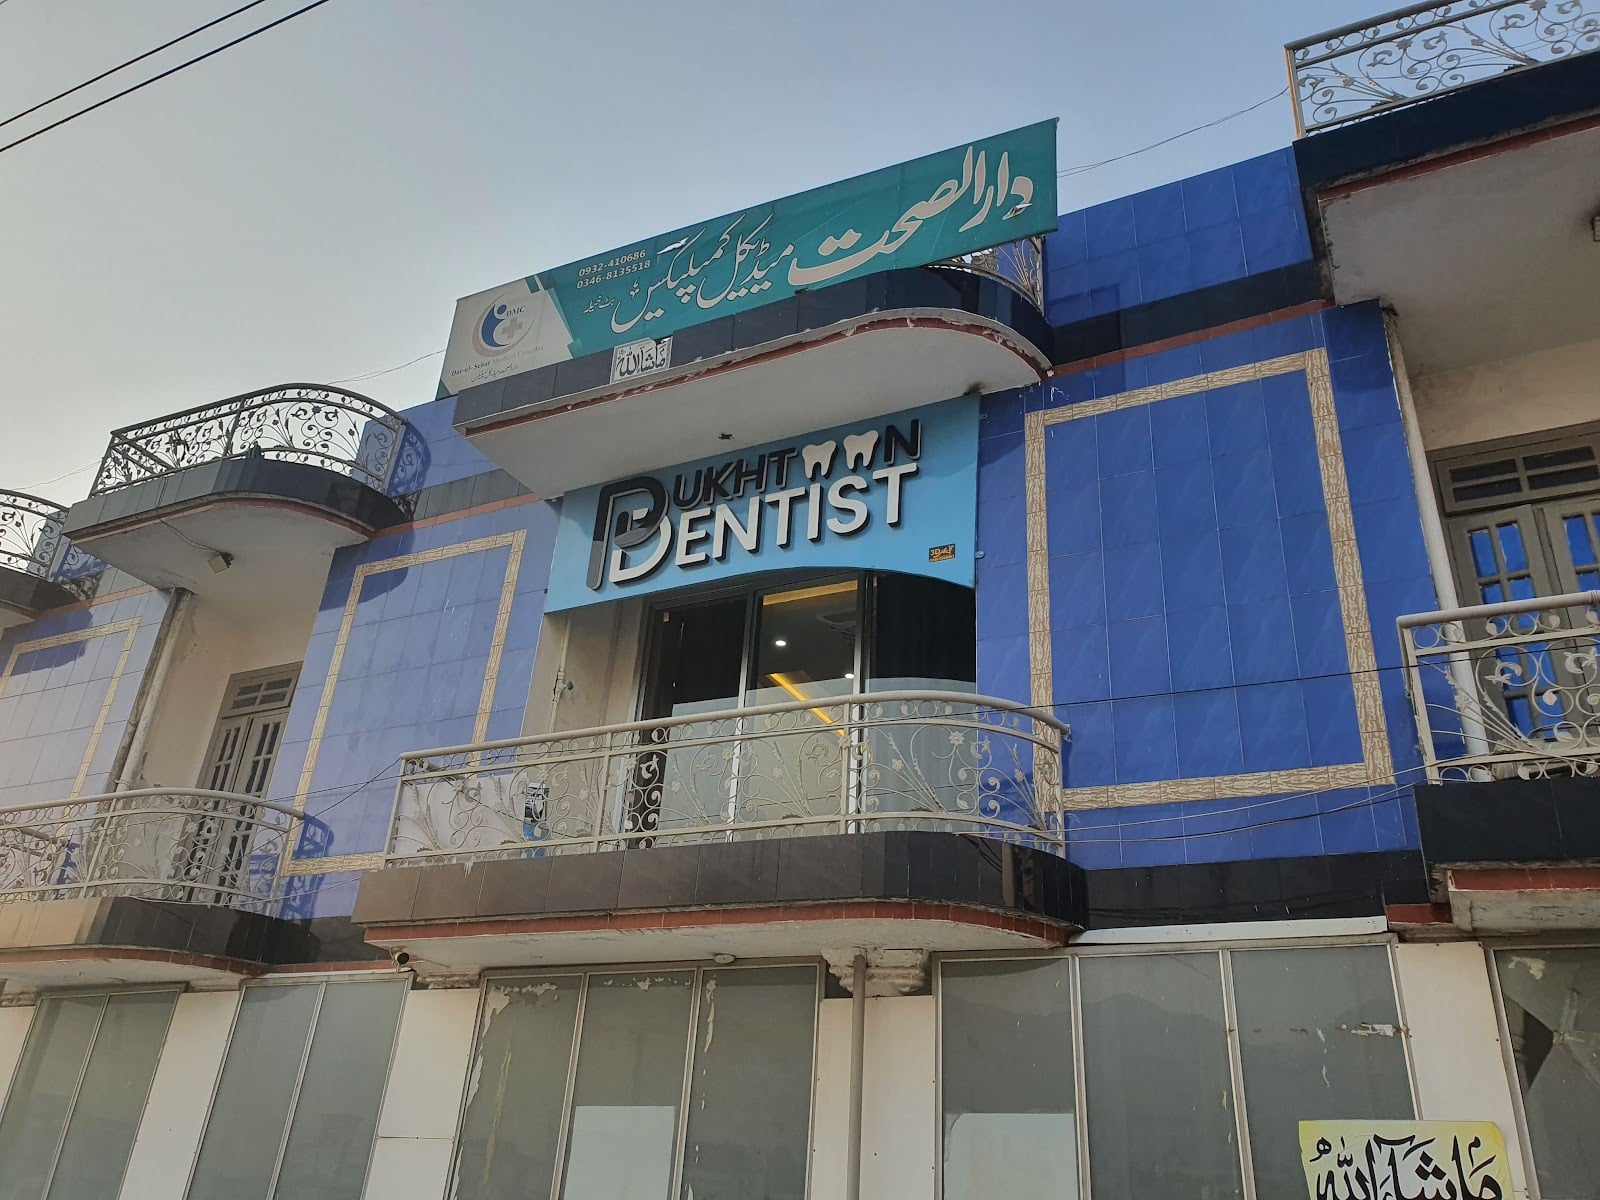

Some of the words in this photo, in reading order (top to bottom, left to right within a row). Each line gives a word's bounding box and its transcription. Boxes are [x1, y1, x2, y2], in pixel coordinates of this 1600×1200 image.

[576, 259, 652, 289] 0346-8135518
[578, 249, 646, 277] 0932-410686
[506, 305, 526, 317] DMC
[609, 462, 919, 585] DENTIST
